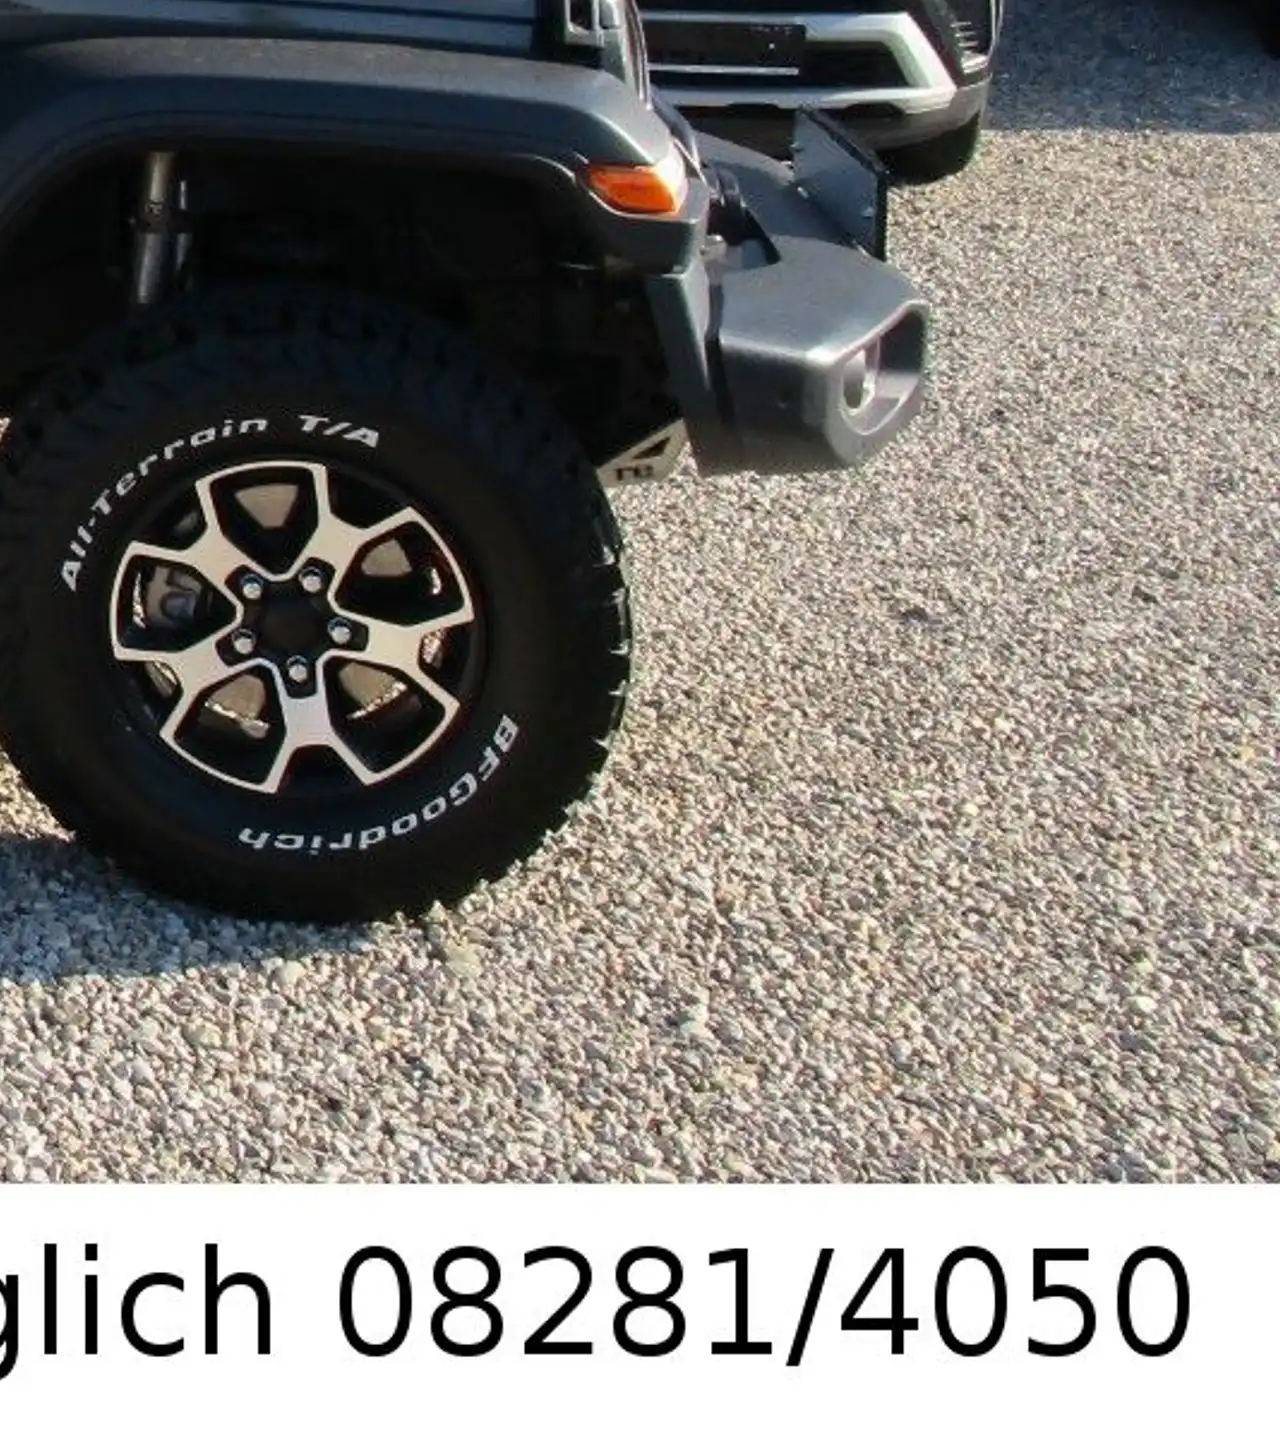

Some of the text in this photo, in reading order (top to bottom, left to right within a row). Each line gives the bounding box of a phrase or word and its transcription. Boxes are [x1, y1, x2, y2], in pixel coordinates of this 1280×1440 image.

[61, 414, 381, 593] All-Terrain T/A
[238, 713, 521, 853] BFGoodrich
